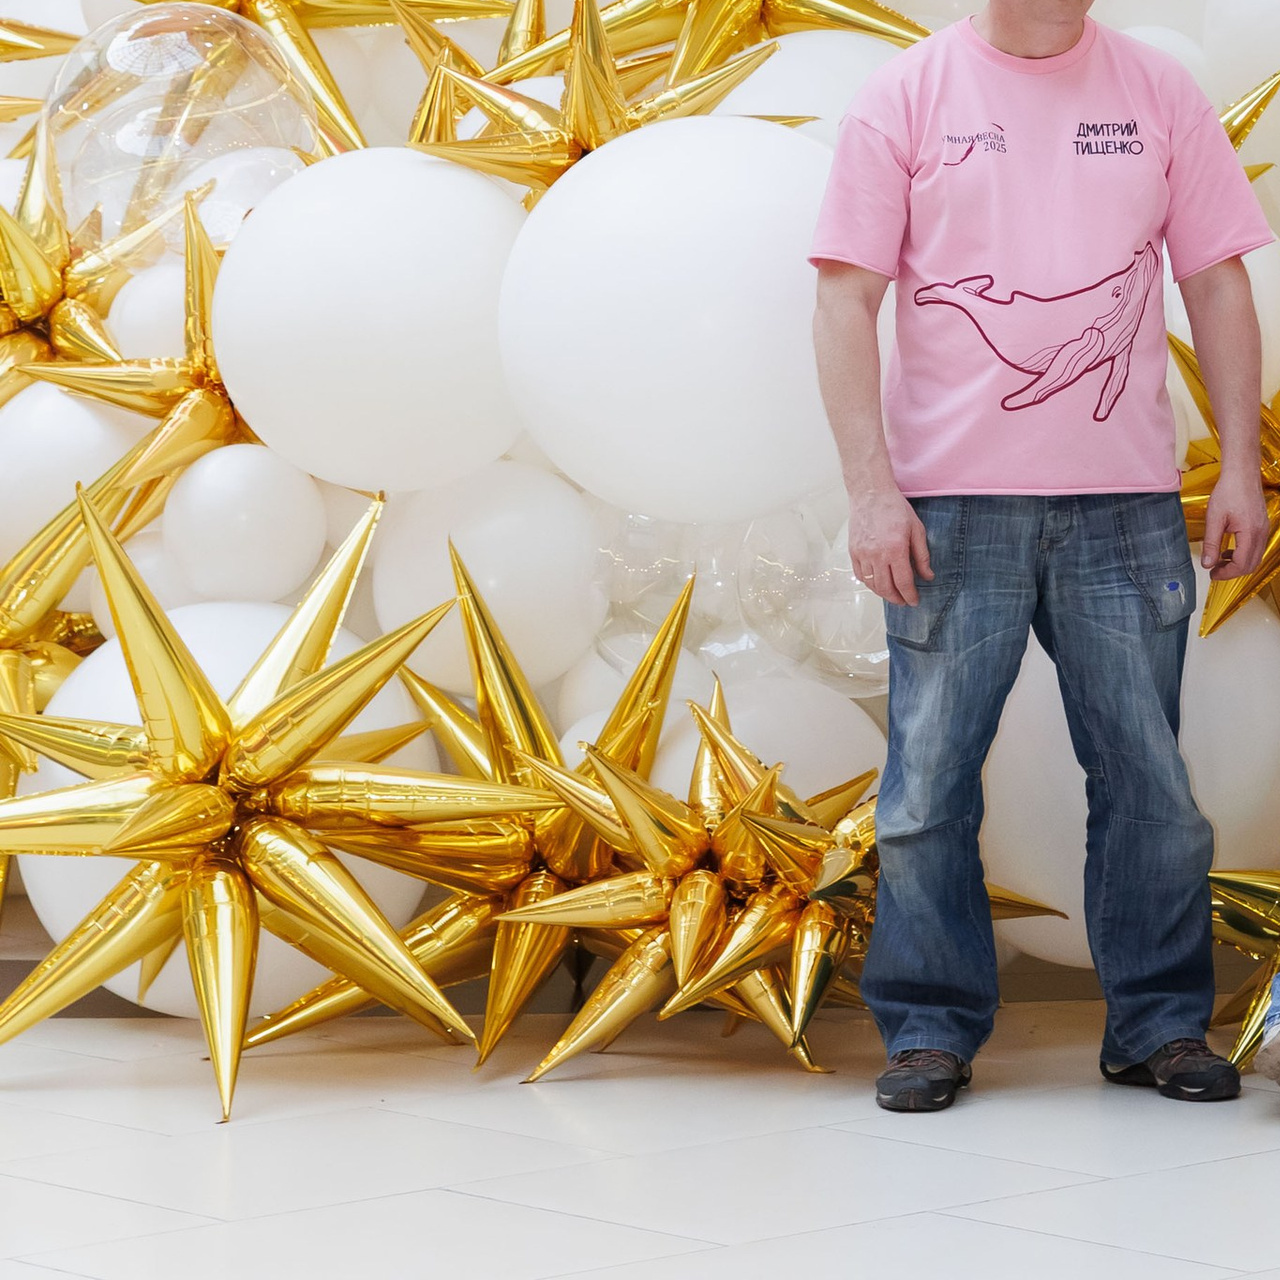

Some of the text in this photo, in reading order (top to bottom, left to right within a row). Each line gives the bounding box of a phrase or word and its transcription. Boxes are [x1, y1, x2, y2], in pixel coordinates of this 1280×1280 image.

[1076, 119, 1138, 138] ДМИТРИЙ
[977, 131, 1005, 143] ВЕСНА
[983, 141, 1007, 154] 2025
[1073, 140, 1144, 156] ТИЩЕНКО
